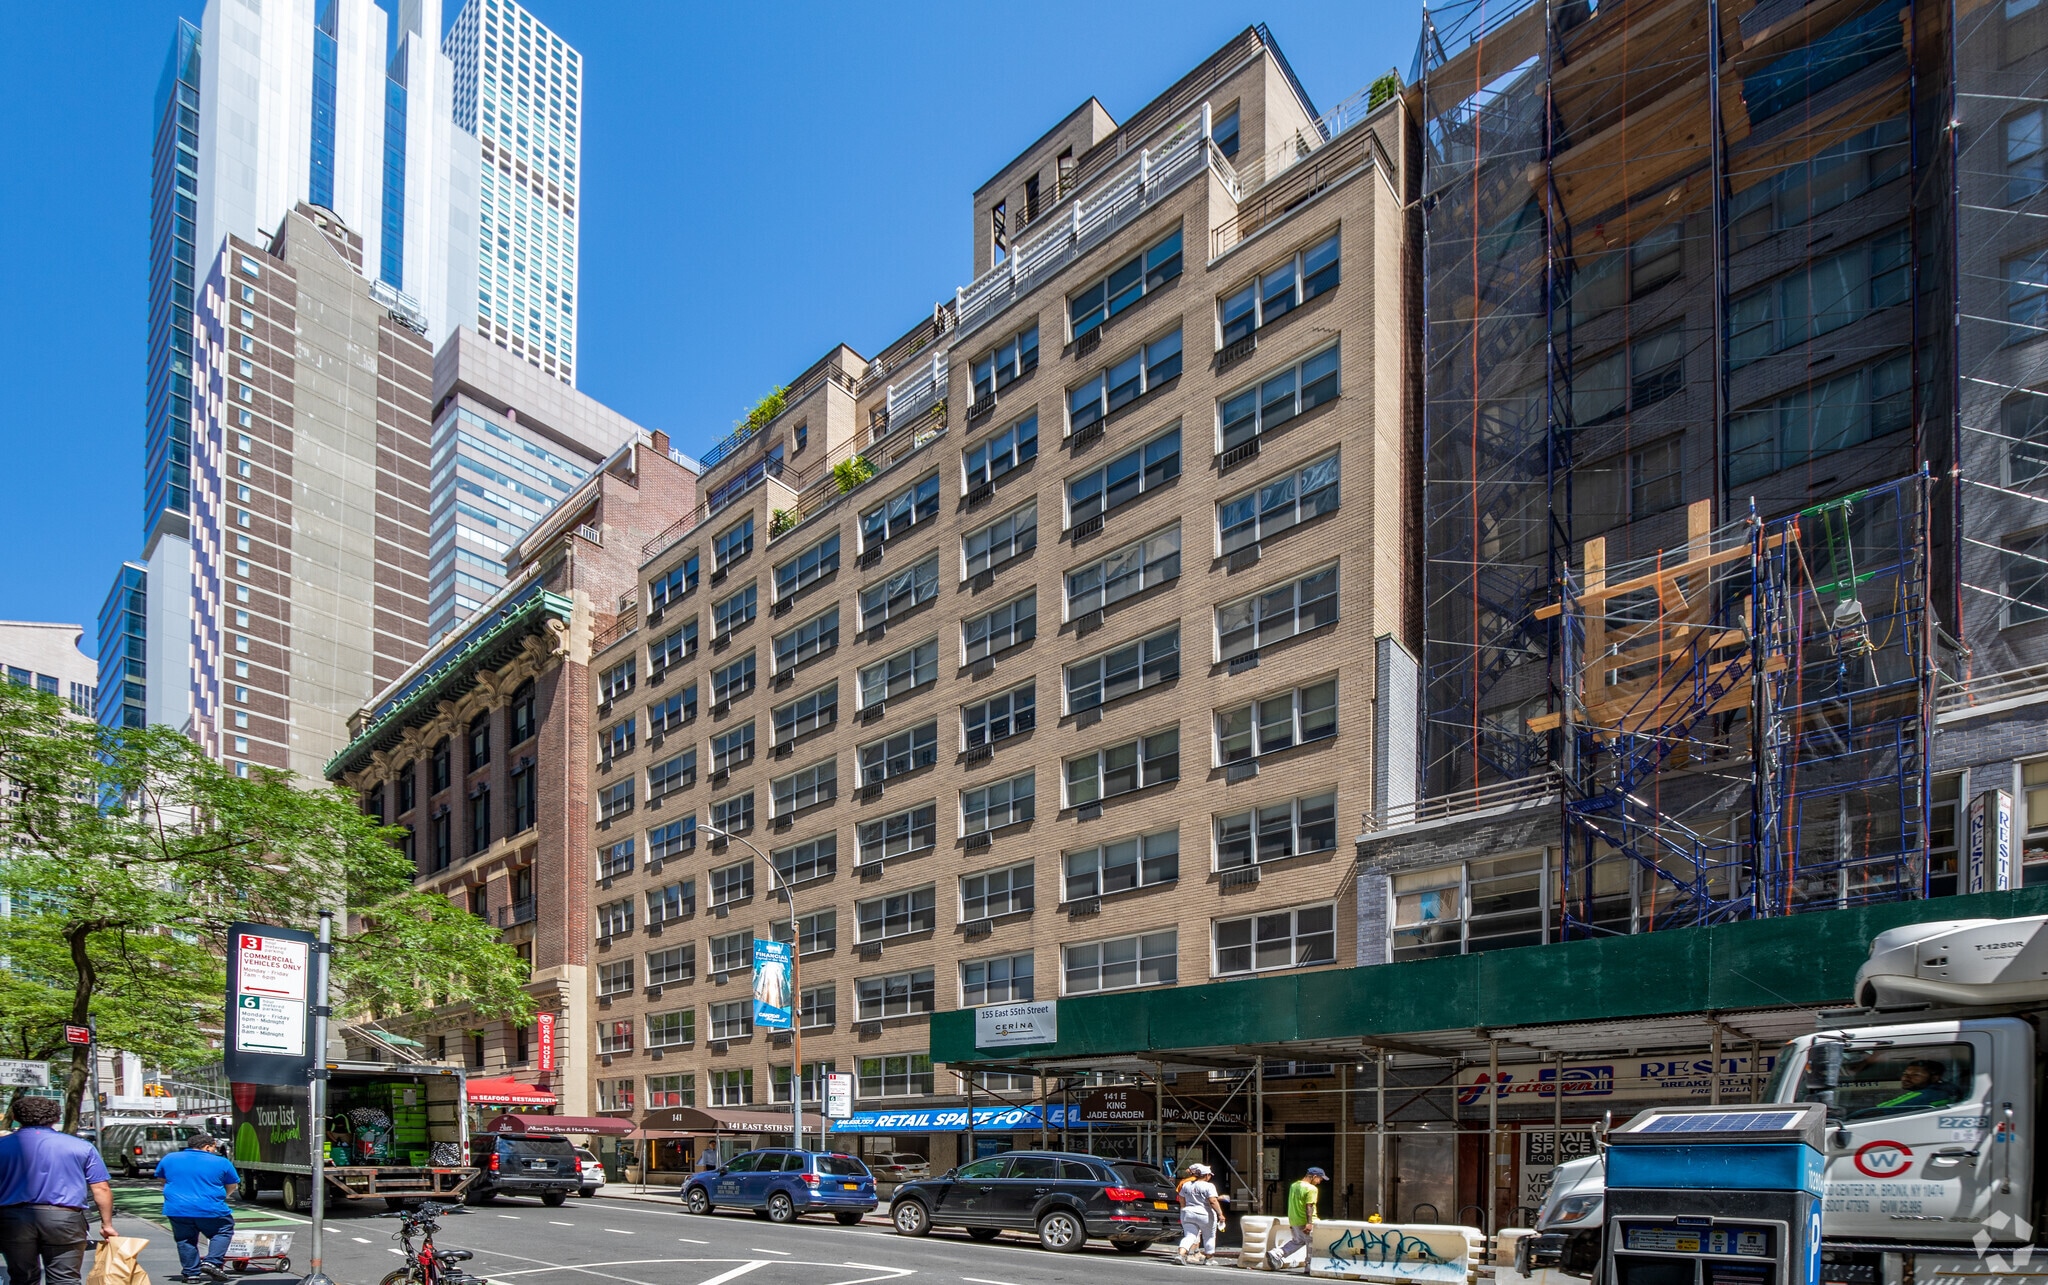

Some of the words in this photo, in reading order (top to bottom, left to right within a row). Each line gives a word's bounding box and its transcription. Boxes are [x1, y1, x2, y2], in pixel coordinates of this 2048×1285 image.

[246, 937, 258, 949] 3
[1974, 941, 2025, 951] T-1280R
[244, 952, 294, 964] COMMERCIAL
[755, 951, 789, 960] FINANCIAL
[244, 959, 281, 969] VEHICLES
[282, 963, 302, 971] ONLY
[244, 997, 256, 1009] 6
[981, 1011, 994, 1019] 155
[995, 1009, 1009, 1018] East
[1010, 1007, 1026, 1016] 55th
[1027, 1005, 1049, 1015] Street
[1661, 1078, 1734, 1088] BREAKFST
[1103, 1092, 1120, 1100] 141
[1120, 1092, 1127, 1100] E
[1106, 1102, 1126, 1110] KING
[256, 1107, 278, 1126] Your
[279, 1105, 296, 1126] list
[672, 1113, 683, 1122] 141
[874, 1114, 930, 1127] RETAIL
[932, 1111, 994, 1126] SPACE
[992, 1110, 1037, 1125] FOR
[1087, 1111, 1108, 1119] JADE
[1110, 1111, 1145, 1119] GARDEN
[1182, 1110, 1205, 1120] JADE
[1207, 1113, 1241, 1123] GARDEN
[270, 1115, 301, 1145] delivered
[728, 1122, 740, 1130] 141
[1532, 1131, 1591, 1143] REAIL
[1531, 1154, 1553, 1163] FOR
[1835, 1184, 1864, 1196] CENTER
[1911, 1184, 1921, 1196] NY
[1822, 1200, 1845, 1212] SDOT
[1809, 1213, 1821, 1283] P
